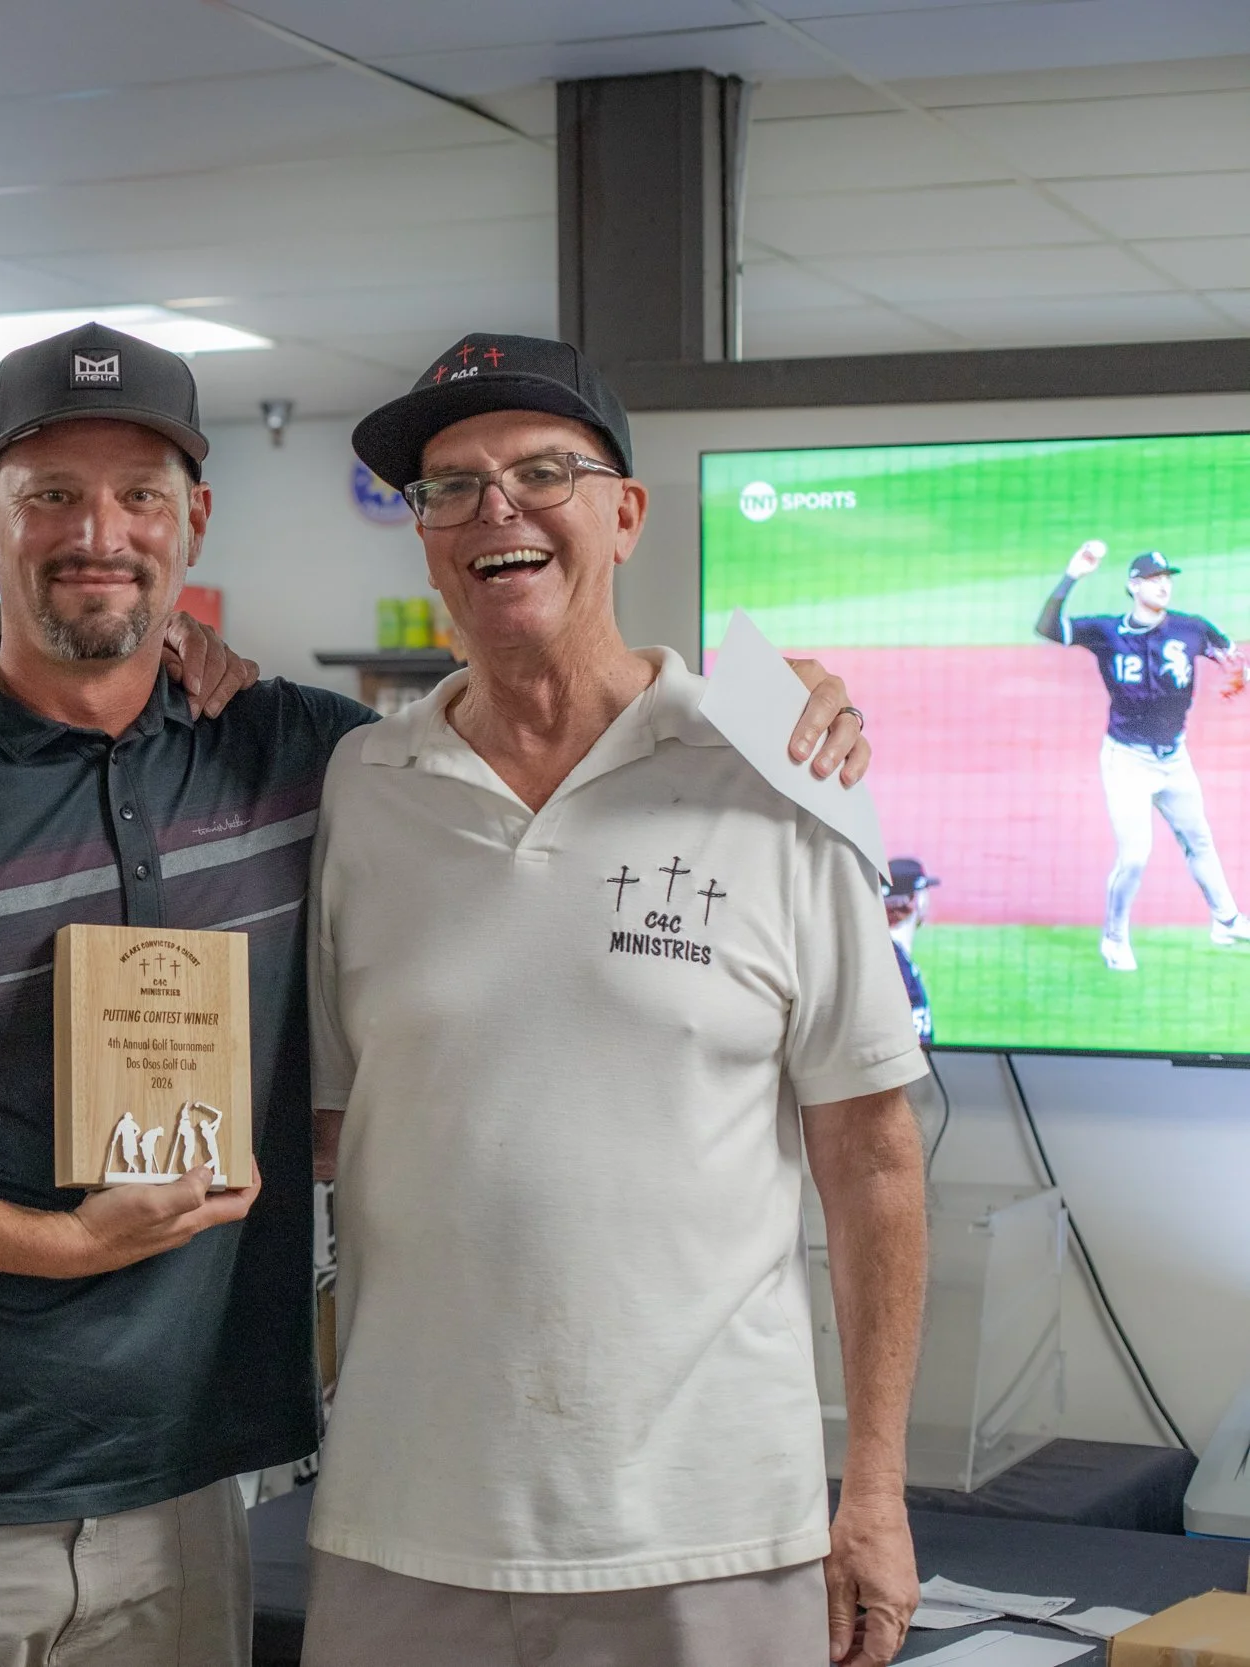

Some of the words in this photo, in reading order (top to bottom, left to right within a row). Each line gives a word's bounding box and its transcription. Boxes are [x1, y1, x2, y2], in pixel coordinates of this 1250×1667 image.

[781, 490, 856, 511] SPORTS
[1114, 653, 1143, 684] 12
[644, 910, 682, 934] C4C
[119, 952, 130, 964] WE
[129, 944, 141, 956] ARE
[140, 940, 175, 949] CONVICTED
[181, 948, 201, 967] CHRIST
[609, 931, 712, 965] MINISTRIES
[153, 978, 168, 987] C4C
[140, 987, 181, 997] MINISTRIES
[102, 1009, 141, 1022] PUTTING
[143, 1010, 182, 1024] CONTEST
[184, 1012, 219, 1026] WINNER
[108, 1037, 121, 1049] 4th
[123, 1038, 150, 1050] Annual
[152, 1038, 168, 1051] Golf
[170, 1039, 215, 1053] Tournament
[126, 1057, 141, 1069] Dos
[142, 1057, 161, 1070] Osos
[162, 1058, 178, 1071] Golf
[180, 1058, 197, 1071] Club
[151, 1077, 173, 1089] 2026
